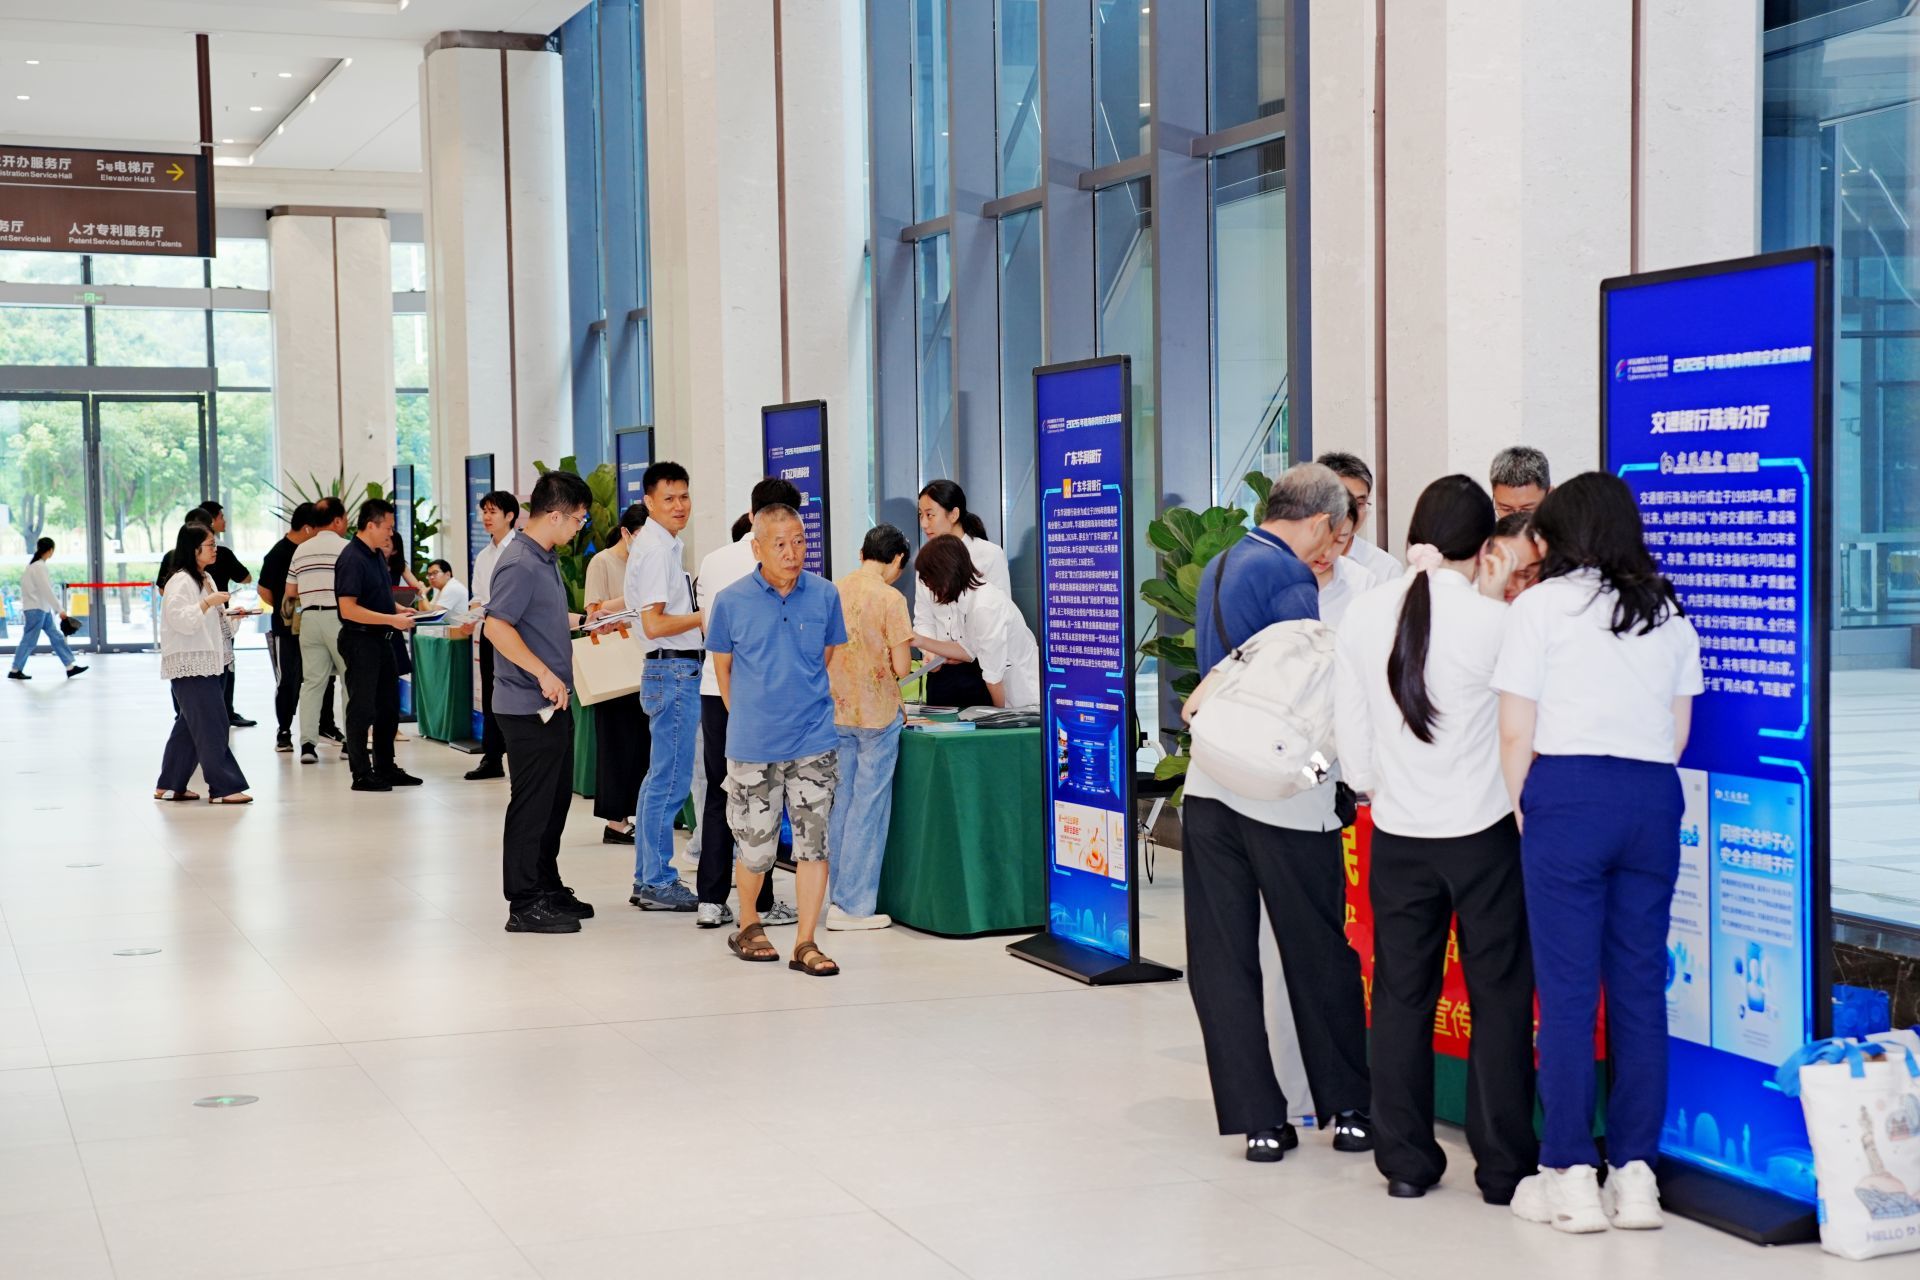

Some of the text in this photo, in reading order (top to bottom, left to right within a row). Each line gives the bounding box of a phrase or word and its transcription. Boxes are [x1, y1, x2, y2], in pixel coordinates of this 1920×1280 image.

[0, 154, 72, 171] 开办服务厅
[96, 159, 154, 175] 5号电梯厅
[30, 171, 58, 179] Service
[58, 172, 73, 180] Hall
[100, 174, 133, 182] Elevator
[134, 175, 149, 183] Hall
[69, 222, 164, 238] 人才专利服务厅
[8, 235, 36, 243] Service
[36, 236, 51, 244] Hall
[68, 237, 183, 248] Patent Service Station for Talents
[1650, 405, 1770, 434] 交通银行珠海分行
[1433, 996, 1472, 1039] 宣传
